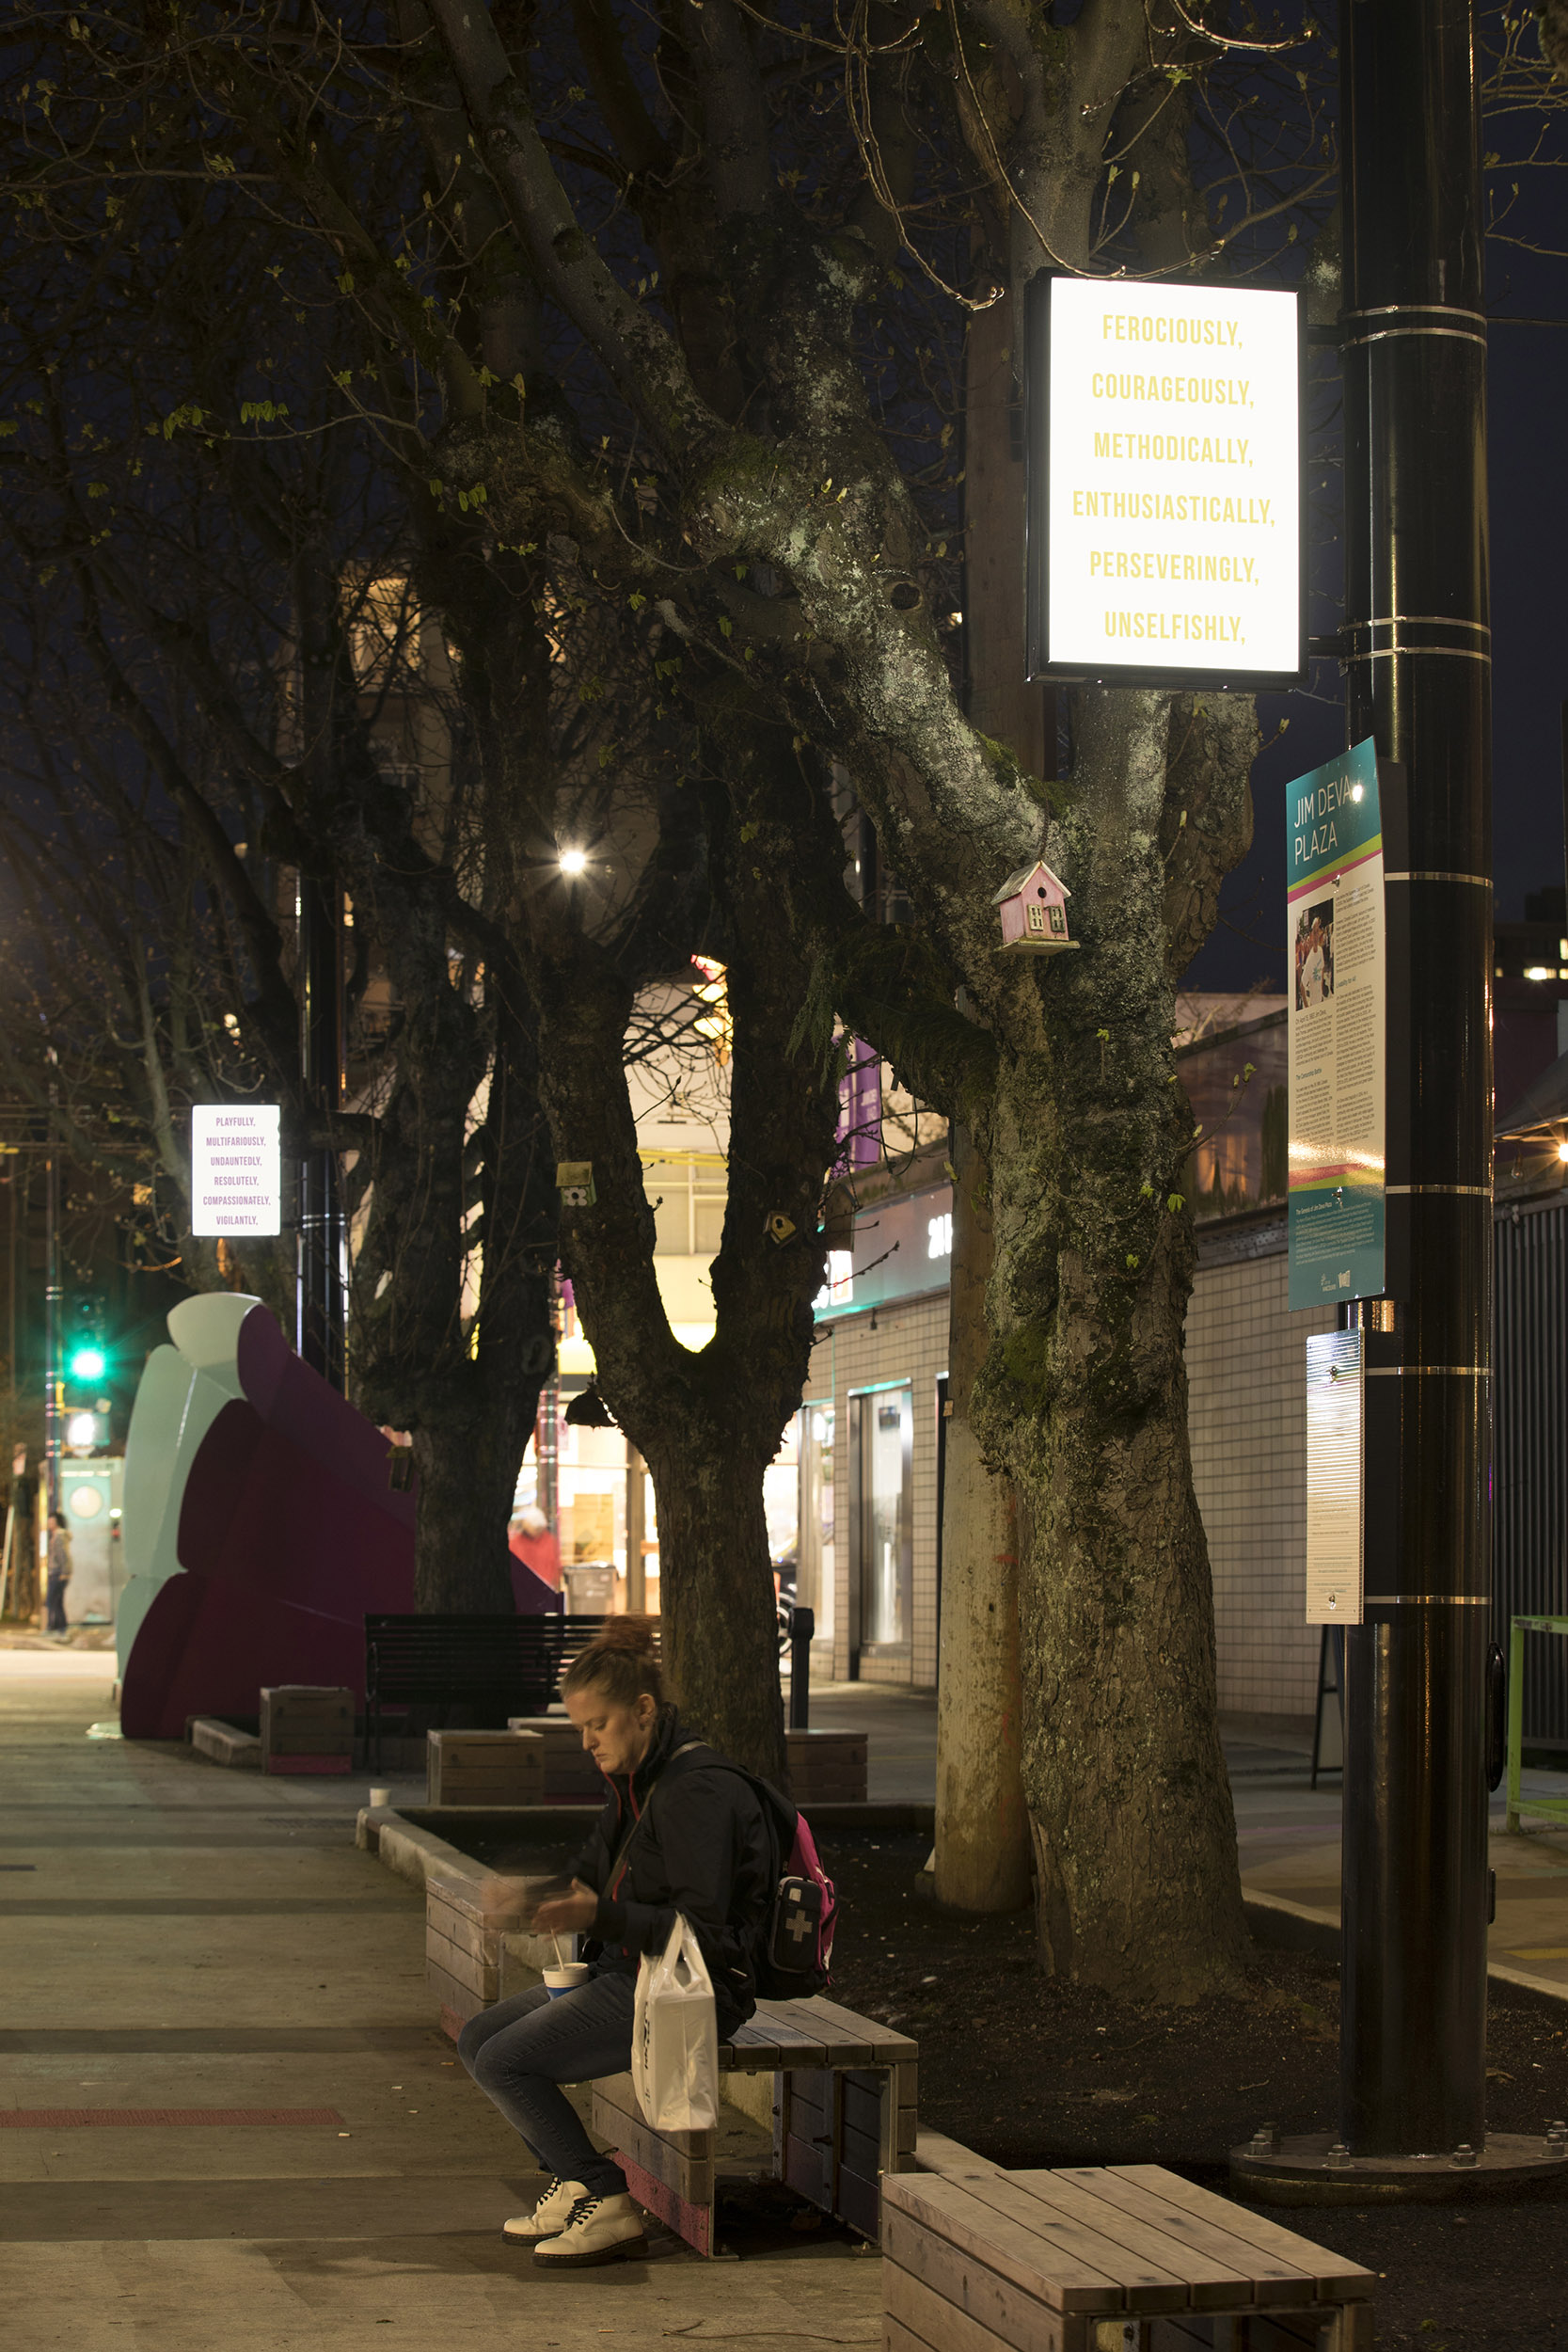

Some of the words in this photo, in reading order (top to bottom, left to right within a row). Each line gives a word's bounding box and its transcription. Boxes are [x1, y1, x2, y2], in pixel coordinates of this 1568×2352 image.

[1102, 313, 1243, 350] FEROCIOUSLY,
[1091, 373, 1255, 408] COURAGEOUSLY,
[1094, 432, 1254, 468] METHODICALLY,
[1072, 490, 1275, 527] ENTHUSIASTICALLY,
[1089, 550, 1259, 586] PERSEVERINGLY,
[1104, 611, 1246, 645] UNSELFISHLY,
[1294, 793, 1315, 828] JIM
[1318, 774, 1353, 817] DEVA
[1294, 820, 1338, 866] PLAZA
[215, 1117, 256, 1127] PLAYFULLY,
[206, 1136, 266, 1147] MULTIFARIOUSLY,
[211, 1156, 262, 1167] UNDAUNTEDLY,
[214, 1176, 259, 1186] RESOLUTELY,
[203, 1196, 271, 1206] COMPASSIONATELY,
[216, 1216, 259, 1226] VIGILANTLY,
